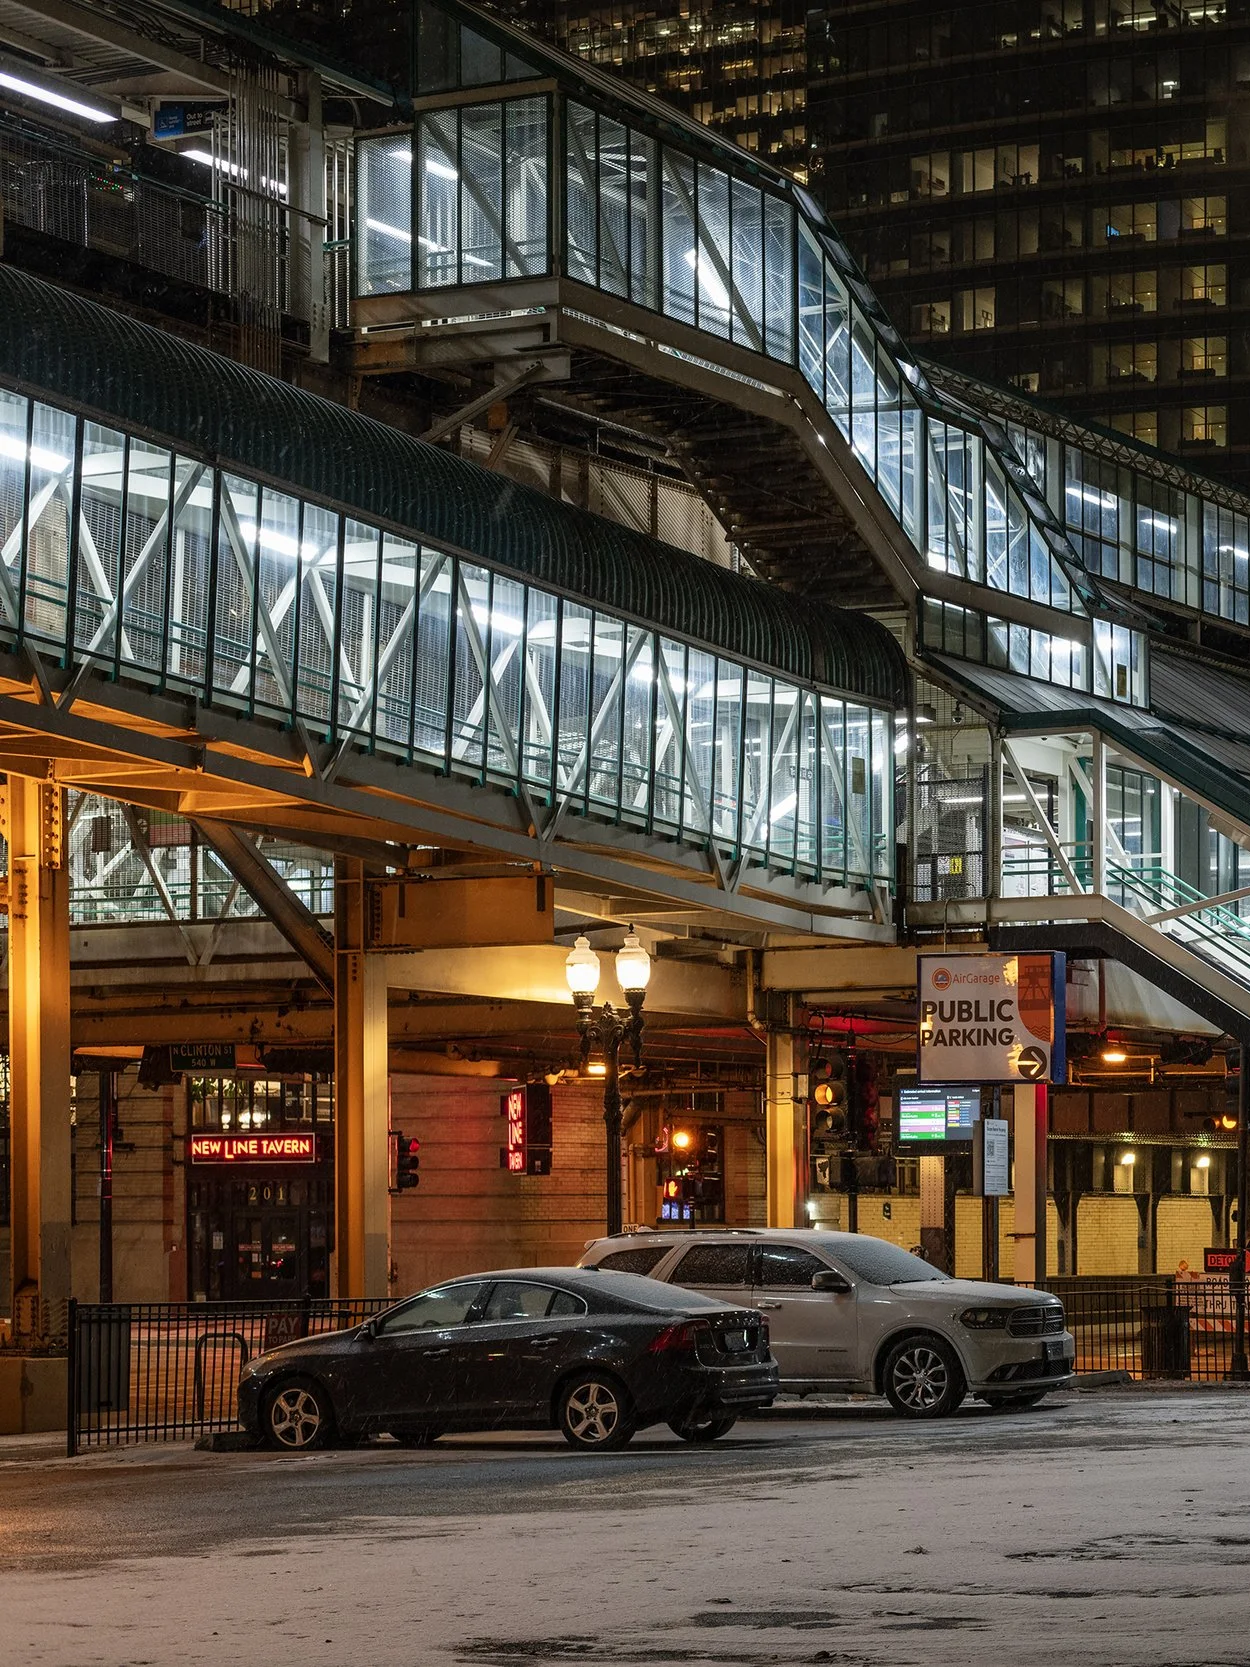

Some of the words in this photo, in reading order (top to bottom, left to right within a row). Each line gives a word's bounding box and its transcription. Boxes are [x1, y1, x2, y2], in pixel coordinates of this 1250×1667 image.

[952, 973, 1000, 985] AirGarage
[921, 999, 1014, 1023] PUBLIC
[921, 1027, 1015, 1047] PARKING
[181, 1045, 222, 1056] CLINTON
[223, 1046, 232, 1055] ST
[191, 1059, 207, 1067] 540
[210, 1058, 216, 1067] W
[508, 1092, 522, 1121] NEW
[508, 1121, 522, 1151] LINE
[192, 1141, 222, 1155] NEW
[224, 1140, 258, 1159] LINE
[261, 1139, 310, 1155] TAVERN
[249, 1186, 285, 1201] 201
[623, 1225, 638, 1233] ONE
[1206, 1277, 1228, 1288] ROAD
[269, 1317, 298, 1334] PAY
[269, 1336, 277, 1344] TO
